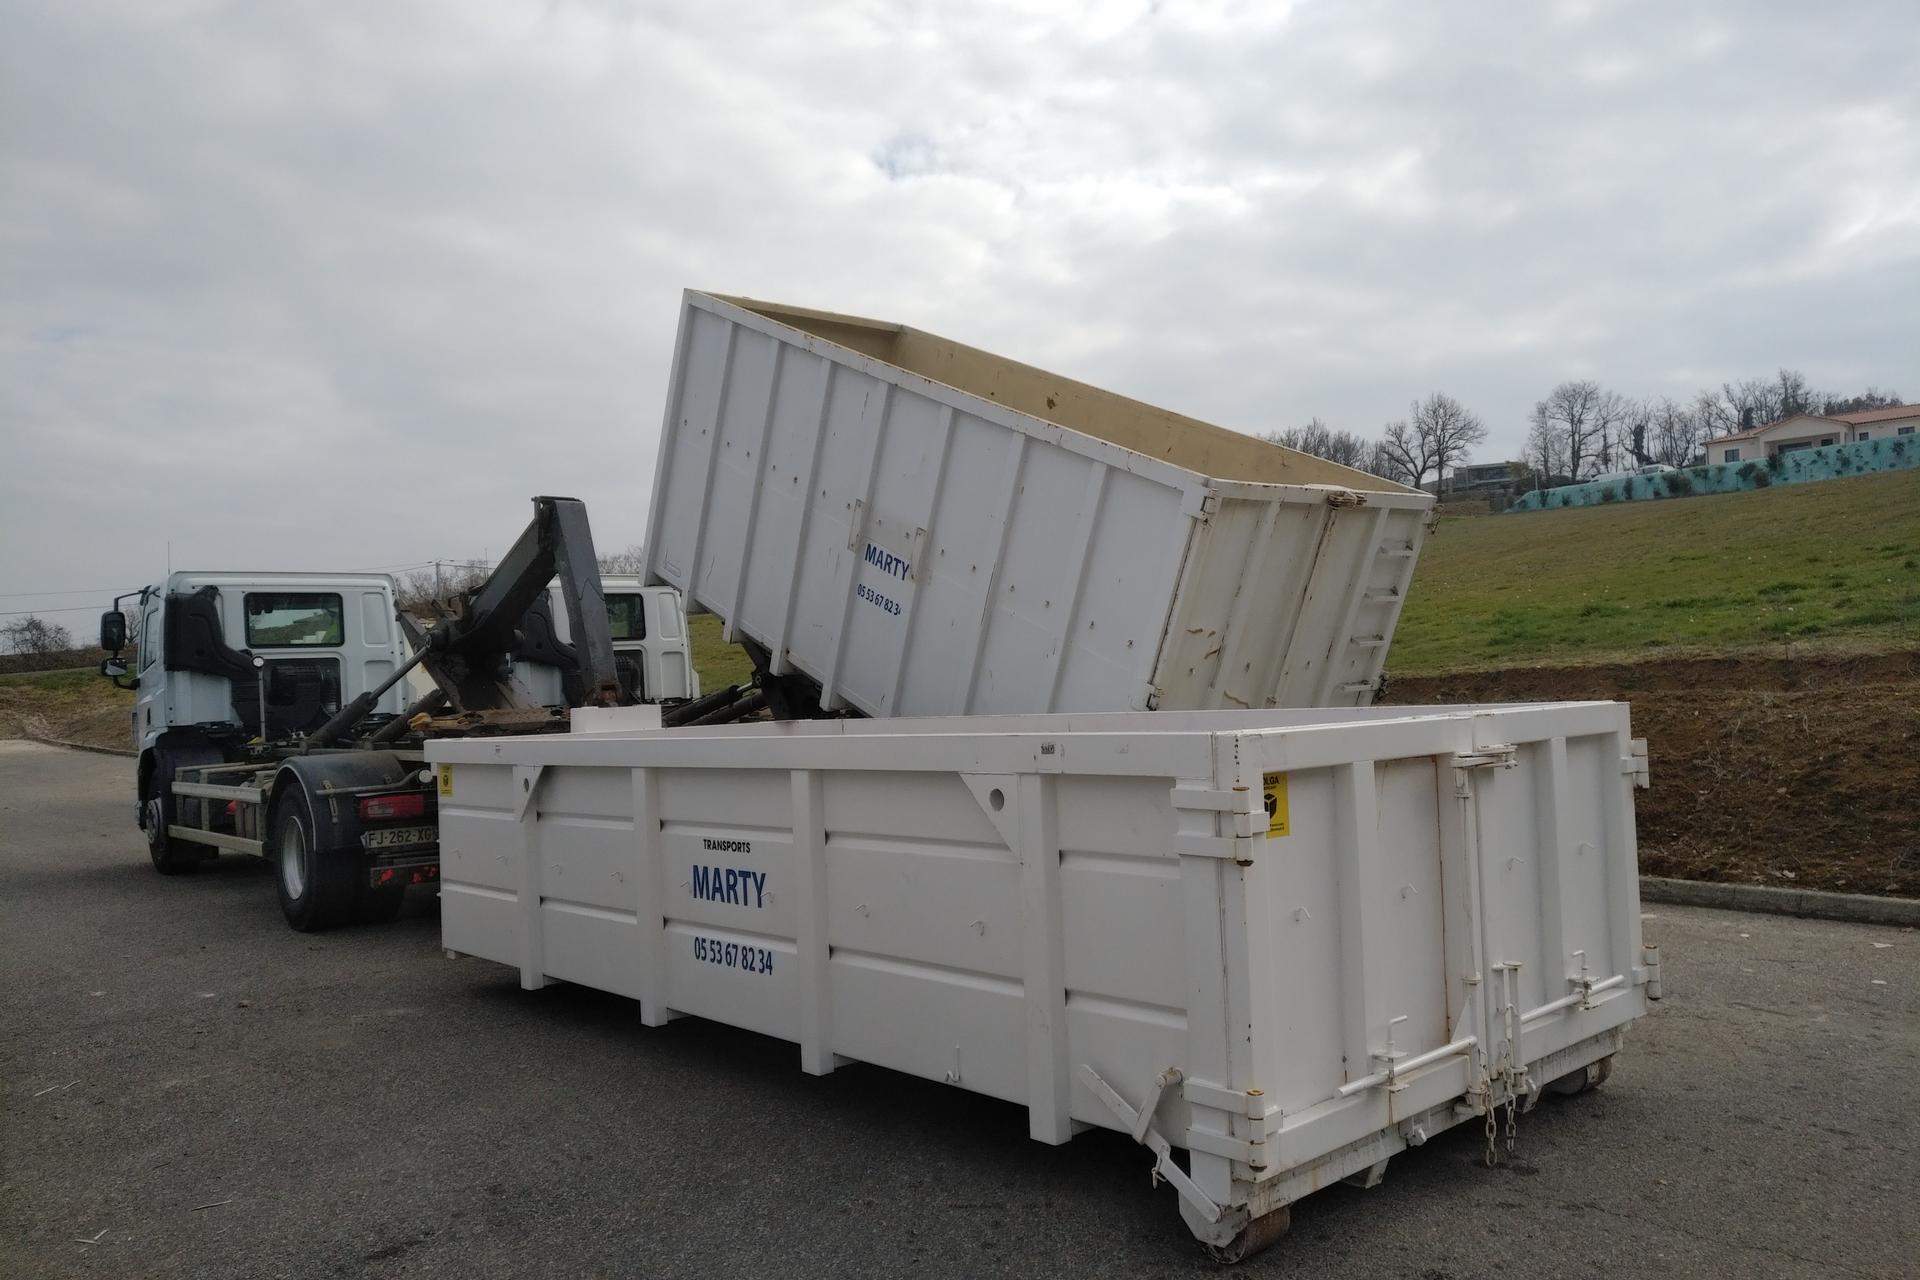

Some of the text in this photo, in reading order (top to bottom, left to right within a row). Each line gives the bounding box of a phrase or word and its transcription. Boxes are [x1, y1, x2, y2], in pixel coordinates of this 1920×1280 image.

[865, 543, 910, 580] MARTY
[857, 583, 866, 597] 05
[866, 588, 875, 602] 53
[874, 593, 884, 607] 67
[884, 598, 893, 613] 82
[703, 839, 751, 853] TRANSPORTS
[692, 864, 767, 909] MARTY
[694, 936, 773, 976] 05 53 67 82 34
